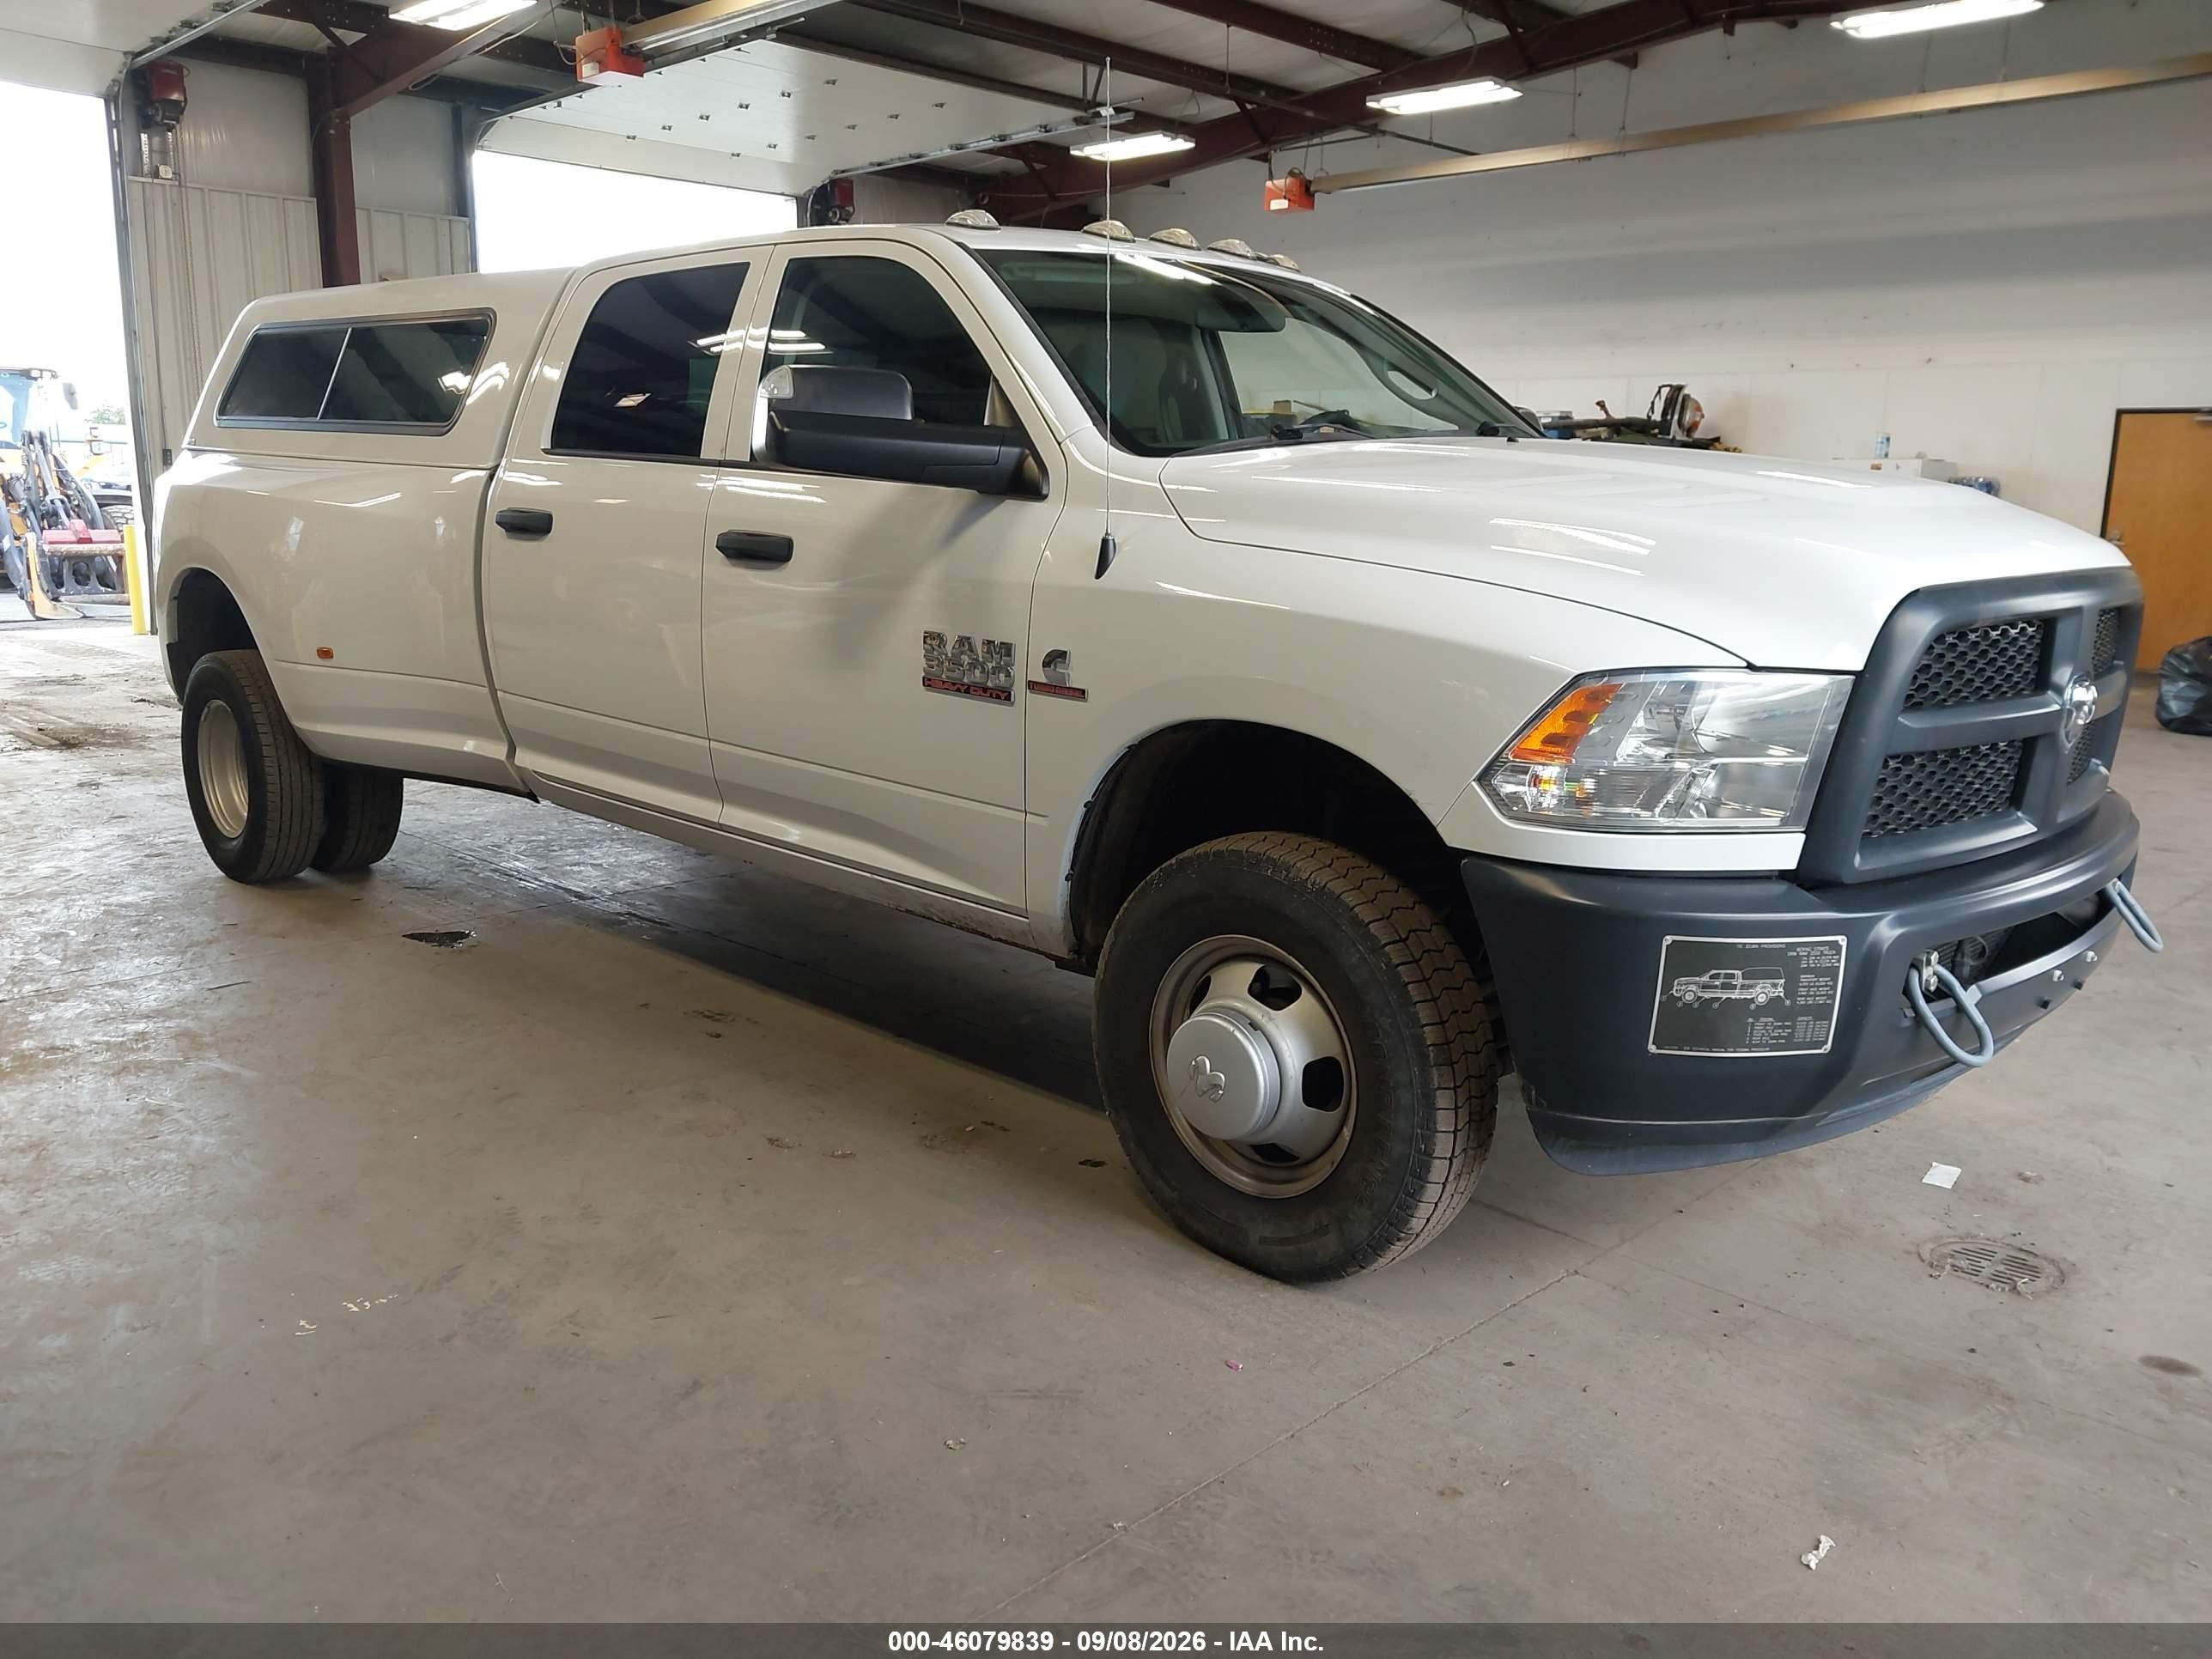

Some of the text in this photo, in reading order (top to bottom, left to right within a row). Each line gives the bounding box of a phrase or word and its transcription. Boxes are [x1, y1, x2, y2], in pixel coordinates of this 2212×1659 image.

[923, 630, 1016, 667] RAM
[923, 653, 1015, 690] 3500
[924, 678, 1010, 701] HEAVY DUTY
